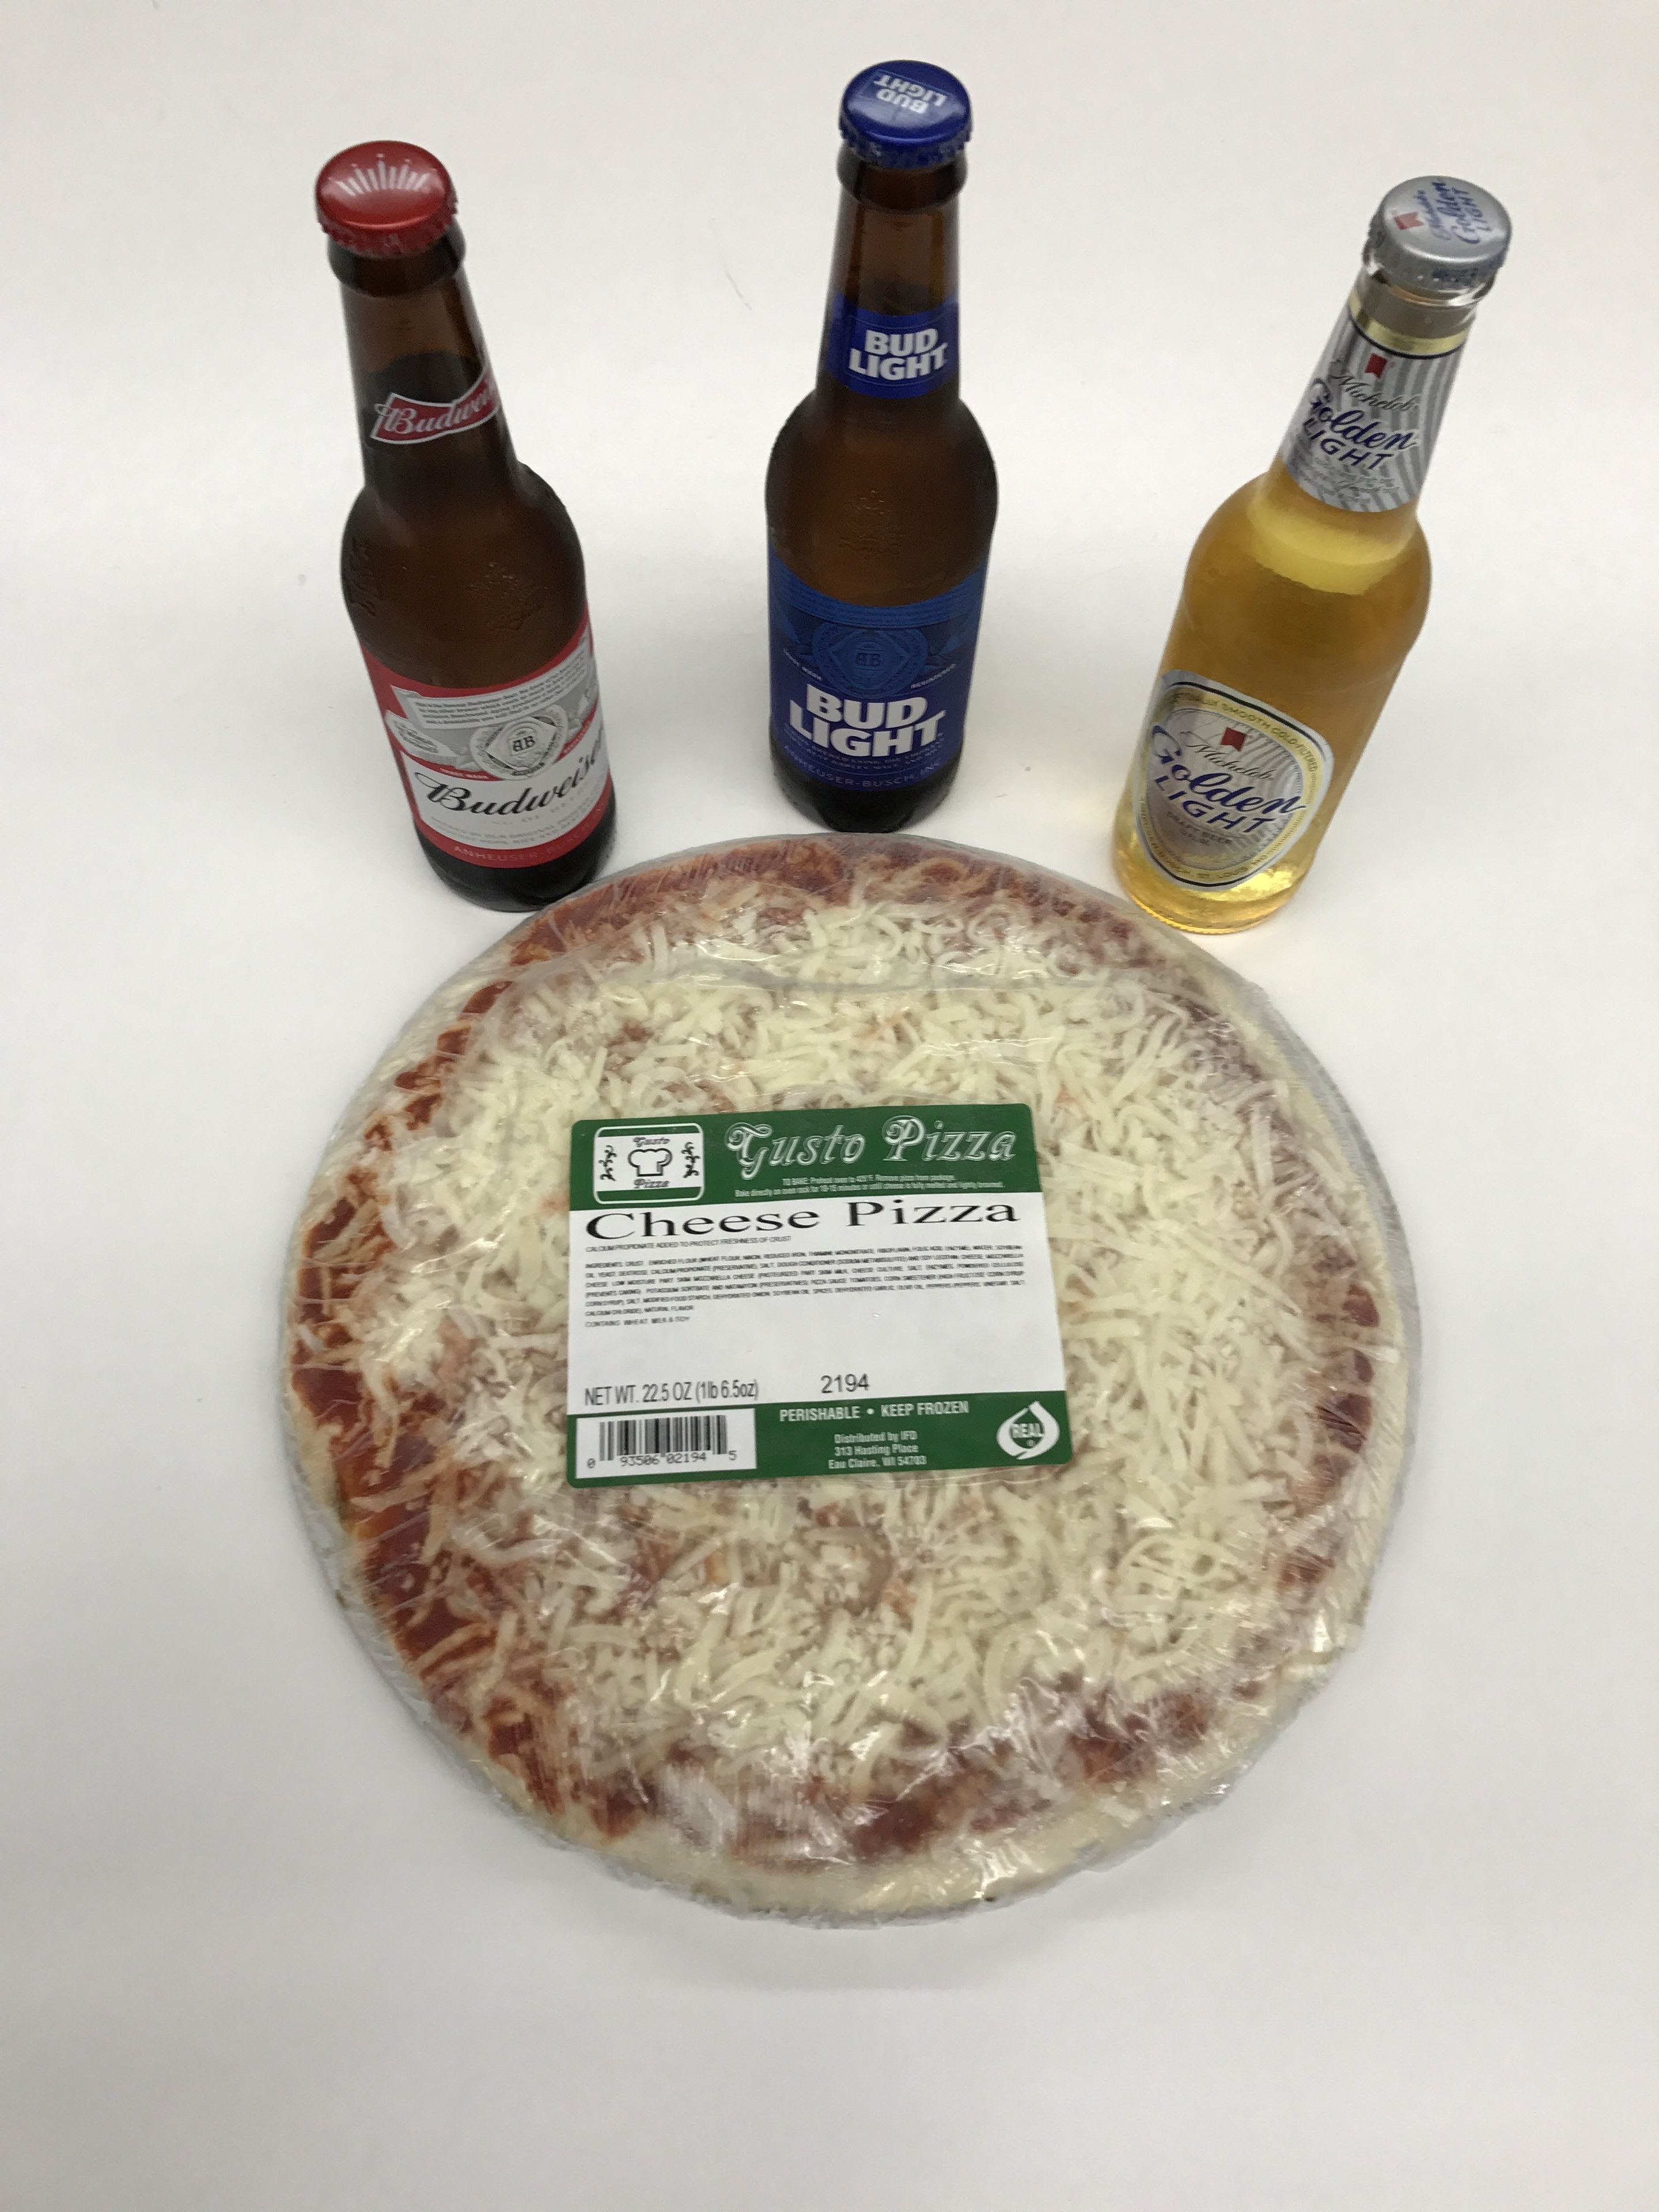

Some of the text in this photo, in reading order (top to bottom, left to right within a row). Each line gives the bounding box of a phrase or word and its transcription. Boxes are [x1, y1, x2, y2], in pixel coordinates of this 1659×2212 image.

[873, 74, 948, 107] LIGHT
[876, 88, 929, 114] BUD
[863, 327, 939, 357] BUD
[849, 342, 948, 381] LIGHT
[1309, 378, 1417, 450] Golden
[1303, 418, 1394, 469] LIGHT
[806, 683, 929, 730] BUD
[789, 699, 946, 757] LIGHT
[1153, 725, 1308, 815] Golden
[1154, 775, 1276, 833] LIGHT
[632, 1136, 671, 1147] Gusto
[724, 1115, 1017, 1181] Gusto Pizza
[633, 1178, 671, 1190] Pizza
[586, 1199, 1021, 1240] Cheese Pizza
[585, 1385, 612, 1406] NET
[615, 1384, 640, 1404] WT.
[642, 1382, 670, 1403] 22.5
[672, 1381, 693, 1401] OZ
[820, 1373, 869, 1393] 2194
[779, 1400, 969, 1422] PERISHABLE KEEP FROZEN
[834, 1431, 887, 1444] Distributed
[887, 1431, 899, 1442] by
[1011, 1422, 1045, 1438] REAL
[619, 1455, 661, 1467] 93506
[665, 1452, 707, 1464] 02194
[728, 1450, 738, 1461] 5
[828, 1459, 847, 1469] Eau
[834, 1446, 853, 1456] 313
[892, 1444, 919, 1453] Place
